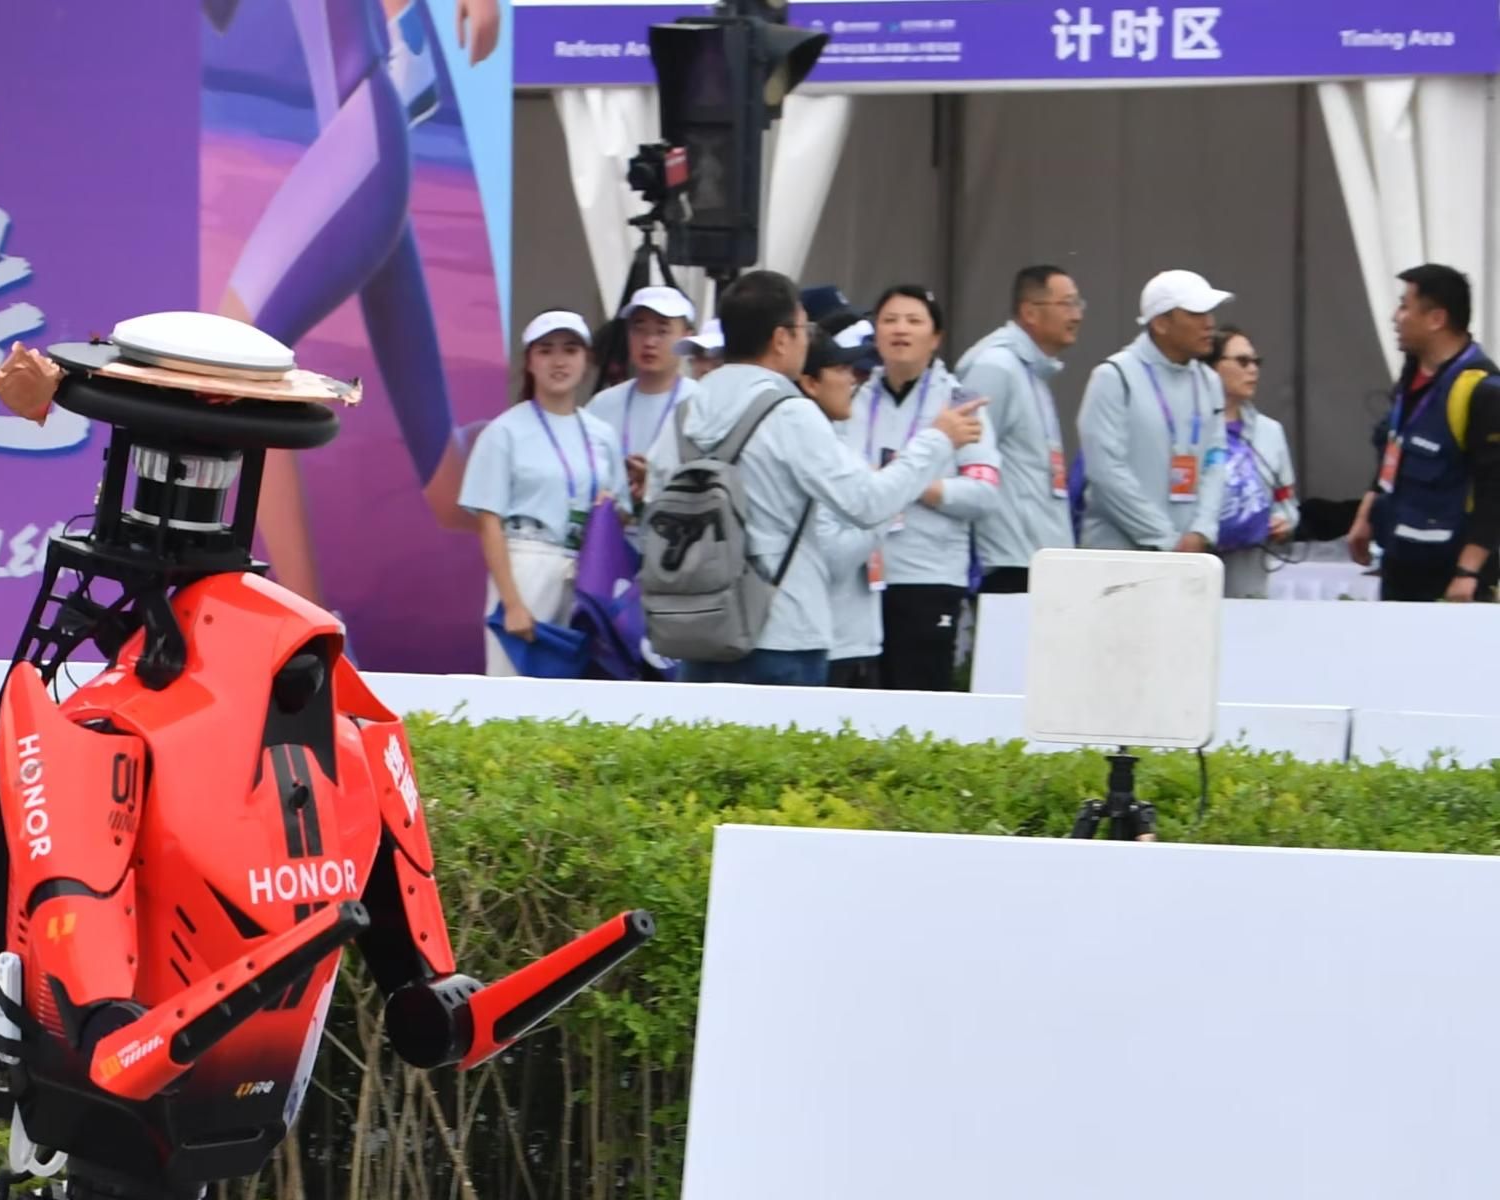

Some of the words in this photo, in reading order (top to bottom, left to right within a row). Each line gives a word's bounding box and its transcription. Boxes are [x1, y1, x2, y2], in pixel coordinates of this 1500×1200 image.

[554, 40, 622, 57] Referee
[1050, 6, 1223, 62] 计时区
[1339, 29, 1406, 51] Timing
[1408, 29, 1456, 46] Area
[18, 733, 52, 861] HONOR
[248, 859, 358, 904] HONOR
